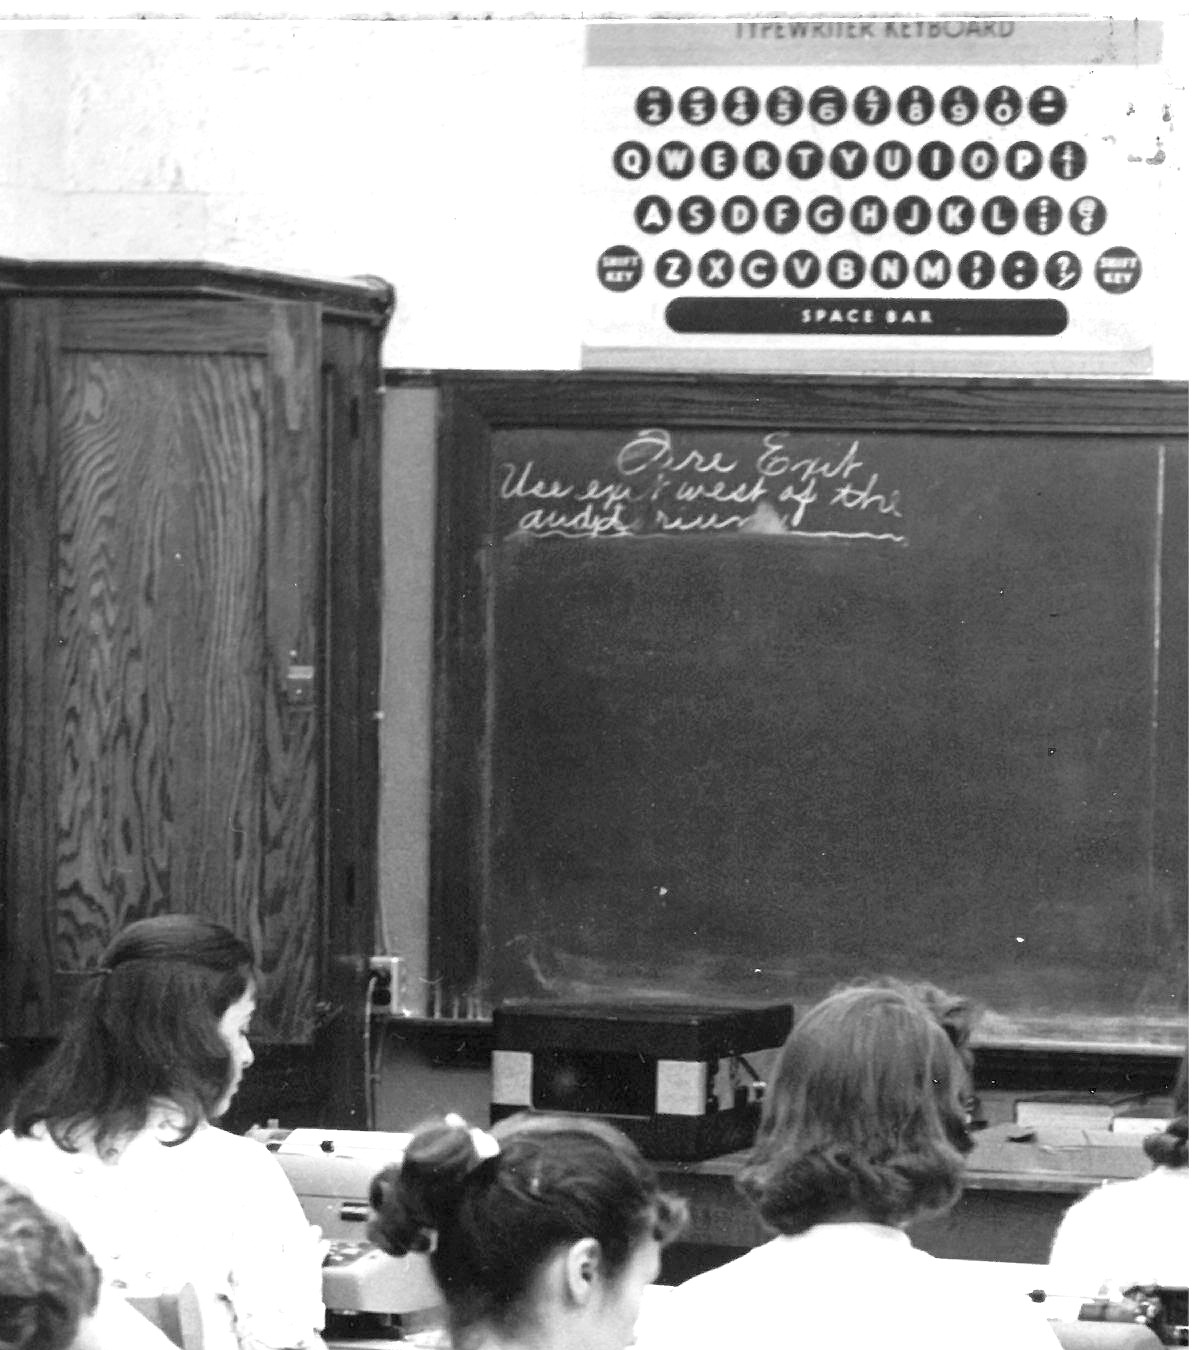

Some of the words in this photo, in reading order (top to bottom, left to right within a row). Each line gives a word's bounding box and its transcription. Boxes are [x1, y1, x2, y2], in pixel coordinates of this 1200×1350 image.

[646, 103, 664, 122] 2
[689, 103, 708, 122] 3
[730, 103, 749, 122] 4
[775, 103, 793, 122] 5
[817, 103, 838, 122] 6
[863, 103, 880, 122] 7
[907, 103, 925, 122] 8
[950, 103, 970, 122] 9
[993, 103, 1014, 122] 0
[621, 148, 643, 175] Q
[661, 148, 691, 172] W
[711, 148, 727, 173] E
[753, 148, 772, 173] R
[795, 148, 816, 172] T
[838, 148, 861, 172] Y
[882, 148, 904, 172] U
[930, 148, 942, 172] I
[968, 148, 992, 174] O
[1013, 147, 1035, 174] P
[640, 203, 665, 228] A
[687, 203, 705, 228] S
[730, 203, 751, 228] D
[773, 203, 791, 228] F
[812, 203, 835, 228] G
[859, 203, 880, 228] H
[903, 203, 921, 228] J
[944, 203, 967, 228] K
[990, 203, 1008, 228] L
[663, 256, 684, 282] Z
[705, 256, 727, 282] X
[745, 256, 769, 282] C
[791, 256, 814, 282] V
[836, 256, 857, 282] B
[879, 256, 901, 282] N
[920, 256, 946, 282] M
[801, 308, 874, 324] SPACE
[884, 309, 933, 324] BAR
[756, 431, 864, 482] Exit
[501, 461, 574, 500] Use
[675, 474, 767, 502] west
[778, 474, 817, 528] of
